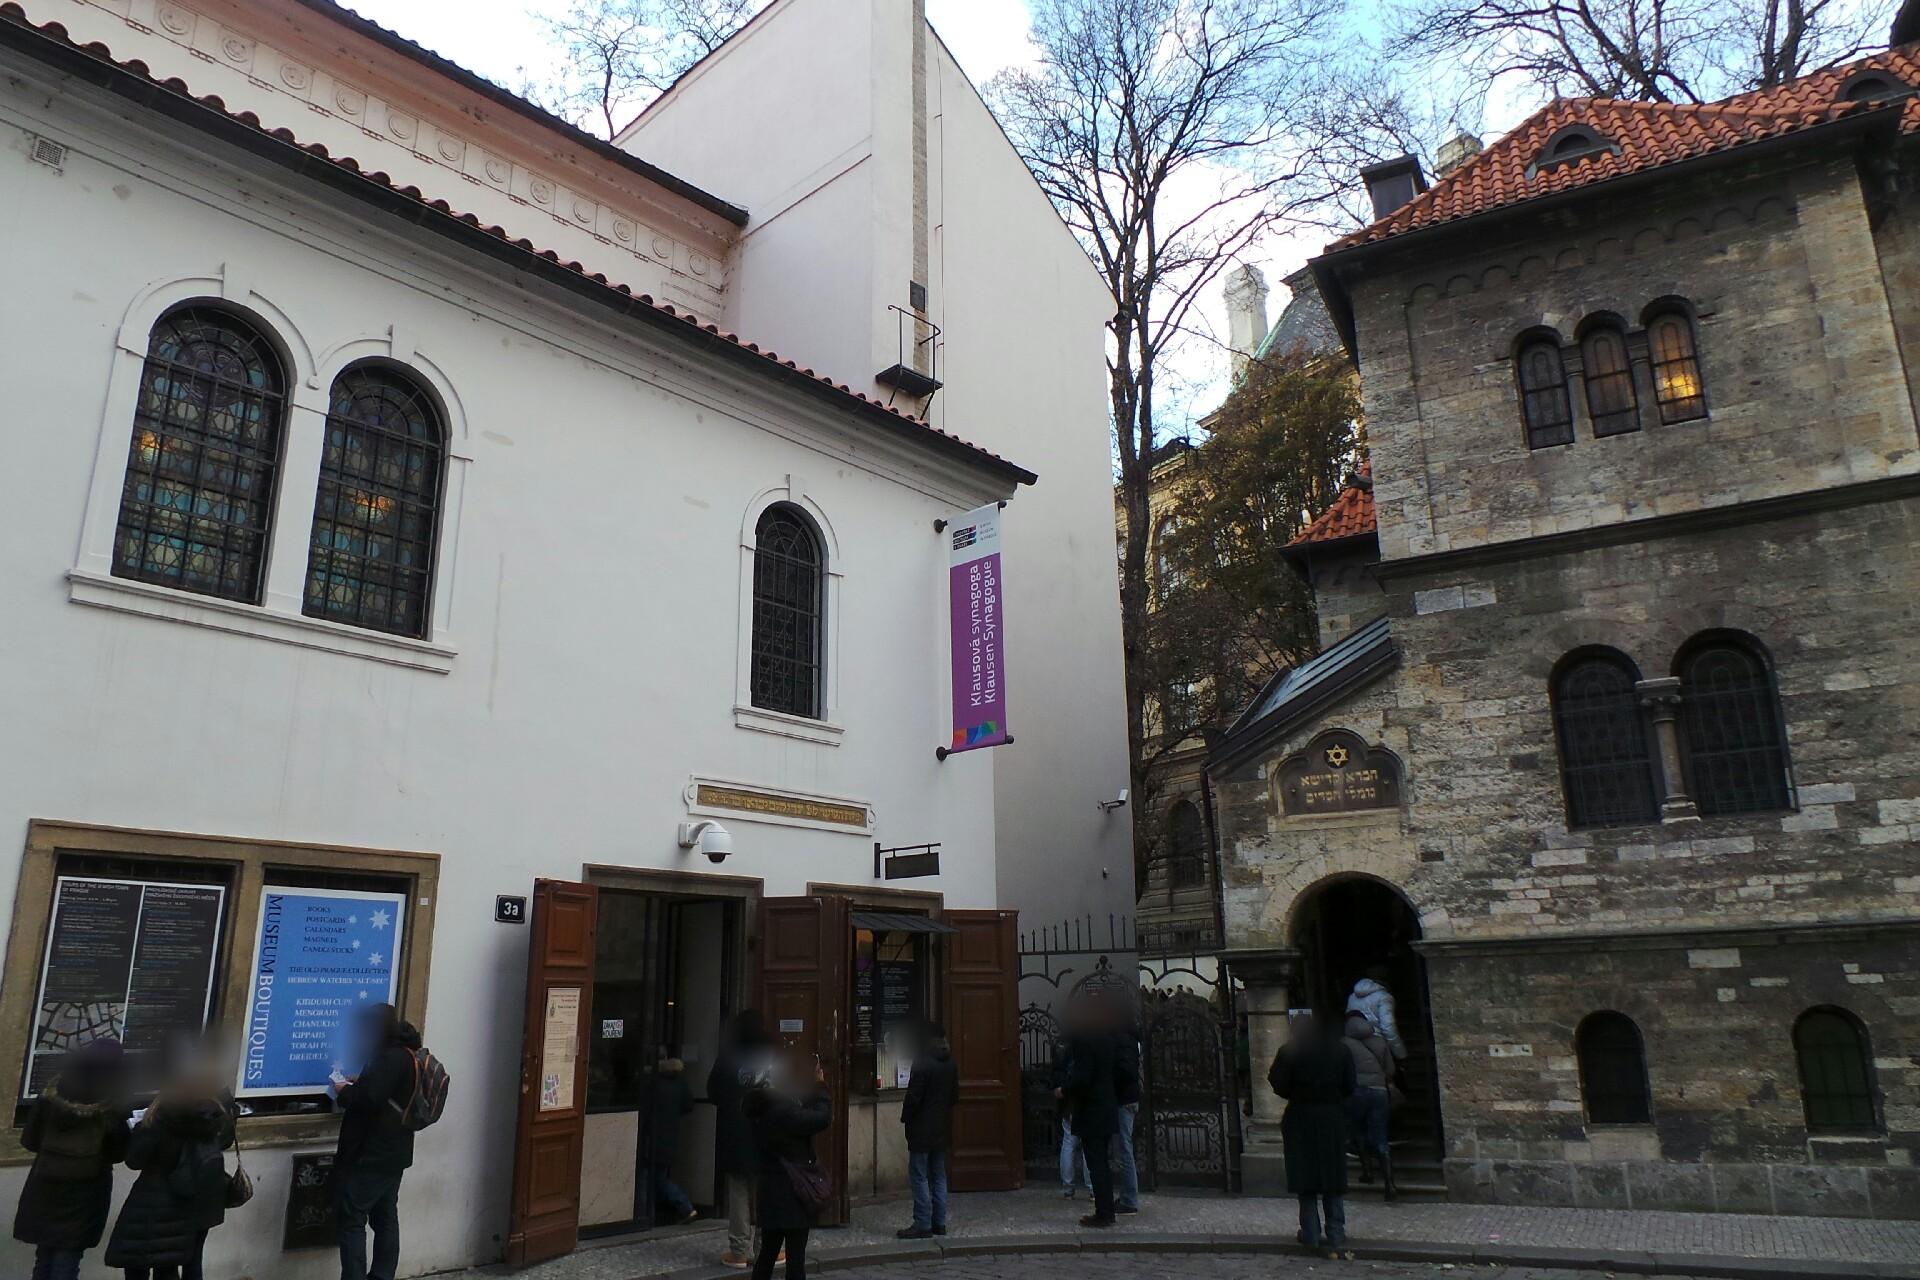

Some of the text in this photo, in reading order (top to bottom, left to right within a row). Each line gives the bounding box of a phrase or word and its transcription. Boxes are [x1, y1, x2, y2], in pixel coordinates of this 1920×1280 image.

[969, 564, 982, 706] Klausová synagoga
[983, 560, 996, 704] Klausen Synagogue
[306, 905, 331, 913] BOOKS
[503, 902, 519, 916] 3a
[305, 916, 346, 924] POSTCARDS
[304, 926, 346, 934] CALENDARS
[302, 946, 354, 954] CANDLESTICKS
[248, 895, 283, 1080] MUSEUM BOUTIQUES
[296, 998, 333, 1006] KIDDUSH
[291, 1042, 319, 1050] TORAH
[289, 1053, 329, 1061] DREIDELS
